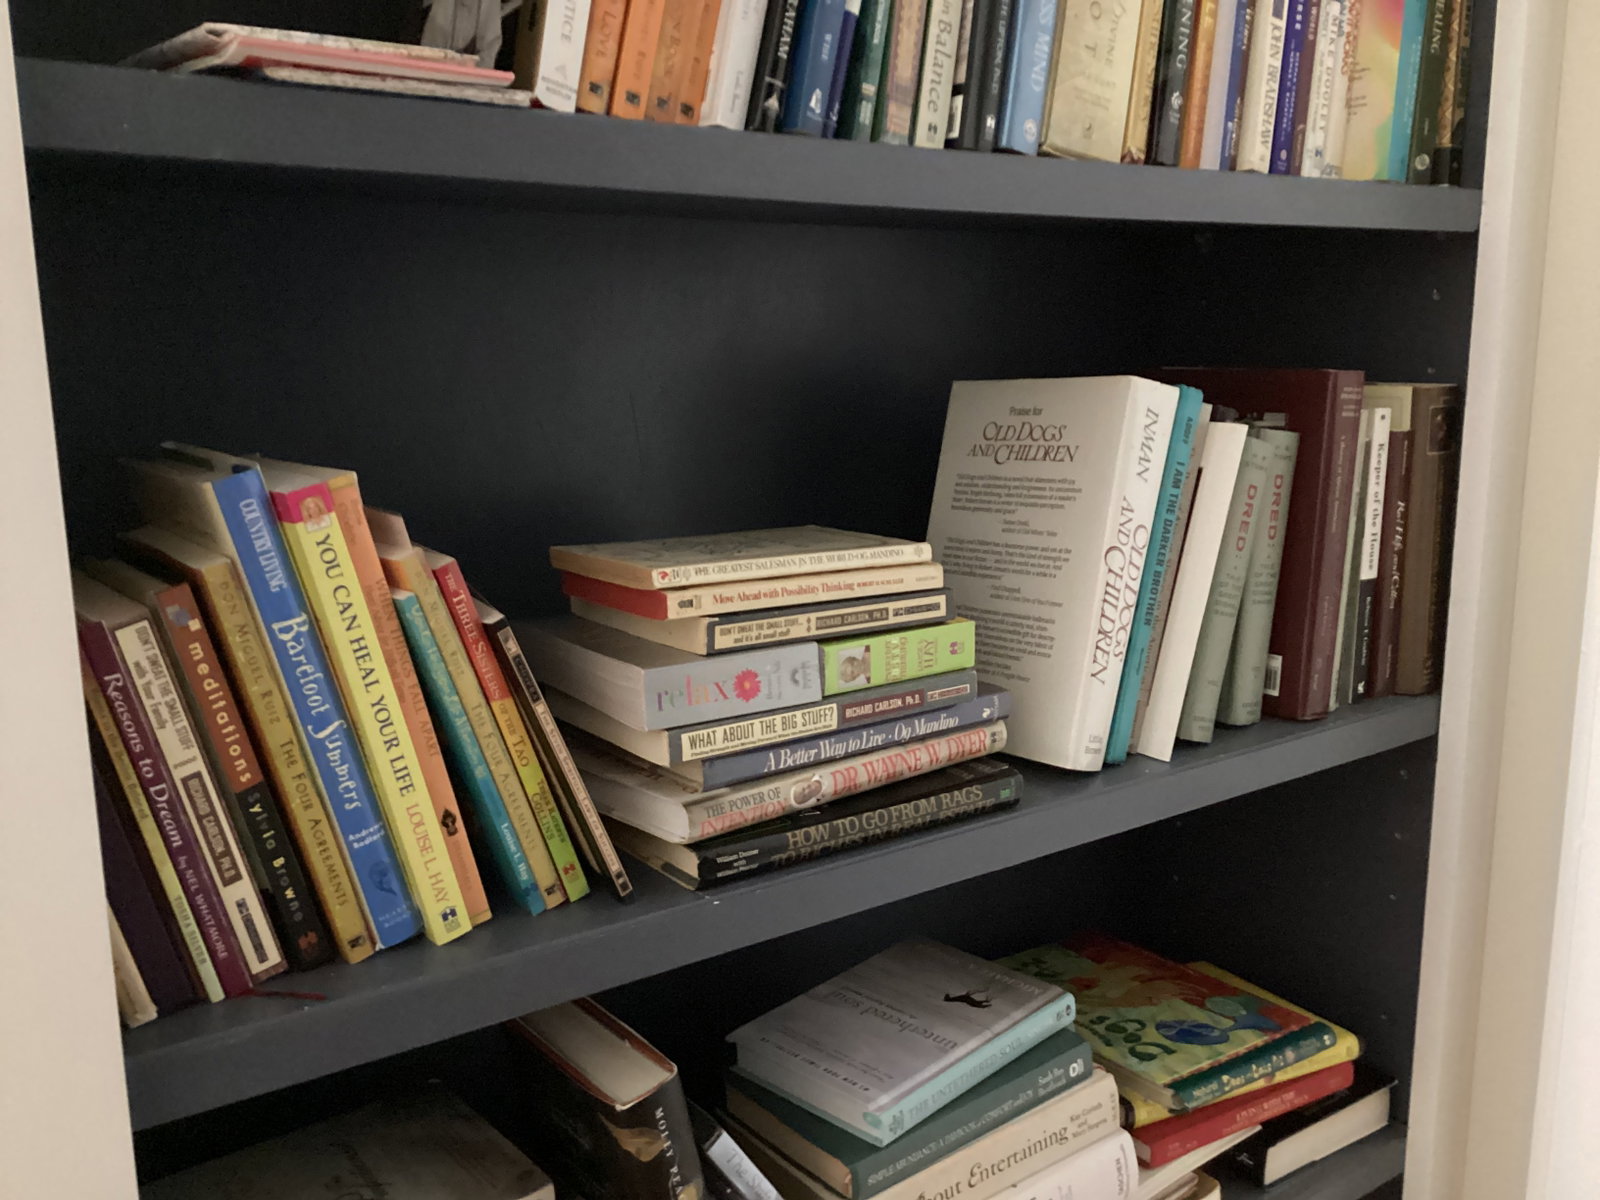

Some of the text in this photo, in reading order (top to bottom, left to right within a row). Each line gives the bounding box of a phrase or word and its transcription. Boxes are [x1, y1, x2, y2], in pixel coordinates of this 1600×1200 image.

[1030, 31, 1051, 92] MIND
[1326, 14, 1341, 58] MIKE
[928, 18, 953, 113] Balance
[1258, 22, 1284, 152] JOHN BRADSHAW
[1315, 64, 1335, 133] DOOLEY
[982, 420, 1067, 442] OLD DOGS
[1009, 405, 1044, 417] Praise for
[1183, 416, 1194, 445] ADOFF
[967, 444, 1081, 465] AND CHILDREN
[1135, 407, 1160, 484] INMAN
[1165, 492, 1180, 516] THE
[1171, 469, 1184, 492] AM
[1368, 443, 1386, 571] Keeper of the House
[712, 563, 754, 575] GREATEST
[755, 558, 798, 570] SALESMAN
[809, 553, 825, 565] THE
[1154, 517, 1174, 567] DARKER
[258, 551, 288, 593] LIVING
[736, 591, 761, 603] Ahead
[762, 588, 780, 600] with
[780, 582, 820, 598] Possibility
[821, 580, 856, 593] Thinking
[1089, 495, 1136, 686] AND CHILDREN
[1112, 523, 1150, 663] OLD DOGS
[1143, 569, 1163, 627] BROTHER
[271, 611, 331, 716] Barefoot
[452, 591, 475, 643] THREE
[473, 640, 501, 701] SISTERS
[188, 642, 252, 783] meditations
[315, 533, 344, 579] YOU
[332, 584, 362, 633] CAN
[350, 634, 380, 694] HEAL
[370, 694, 401, 753] YOUR
[389, 753, 417, 798] LIFE
[406, 803, 434, 858] LOUISE
[428, 872, 450, 904] HAY
[407, 679, 421, 716] FALL
[419, 719, 440, 759] APART
[656, 673, 730, 712] relax
[845, 703, 874, 719] RICHARD
[904, 695, 921, 706] Ph.D.
[511, 735, 530, 768] TAO
[688, 706, 835, 750] WHAT ABOUT THE BIG STUFF?
[763, 714, 960, 772] A Better Way to Live Og Mandino
[830, 727, 988, 797] DR. WAYNE W. DYER
[103, 672, 144, 753] Reasons
[138, 758, 155, 778] to
[149, 783, 184, 848] Dream
[184, 868, 201, 892] NEL
[194, 893, 229, 960] WHATMORE
[531, 792, 556, 842] COLLINS
[698, 797, 788, 838] INTENTION
[704, 786, 782, 819] THE POWER OF
[786, 784, 983, 850] HOW TO GO FROM RAGS
[292, 773, 315, 813] FOUR
[309, 817, 351, 907] AGREEMENTS
[501, 822, 517, 854] Louise
[517, 861, 529, 881] Hay
[272, 856, 303, 922] Browne
[860, 1000, 960, 1050] untethered
[654, 1106, 676, 1159] MOLLY
[967, 1124, 1070, 1189] Entertaining
